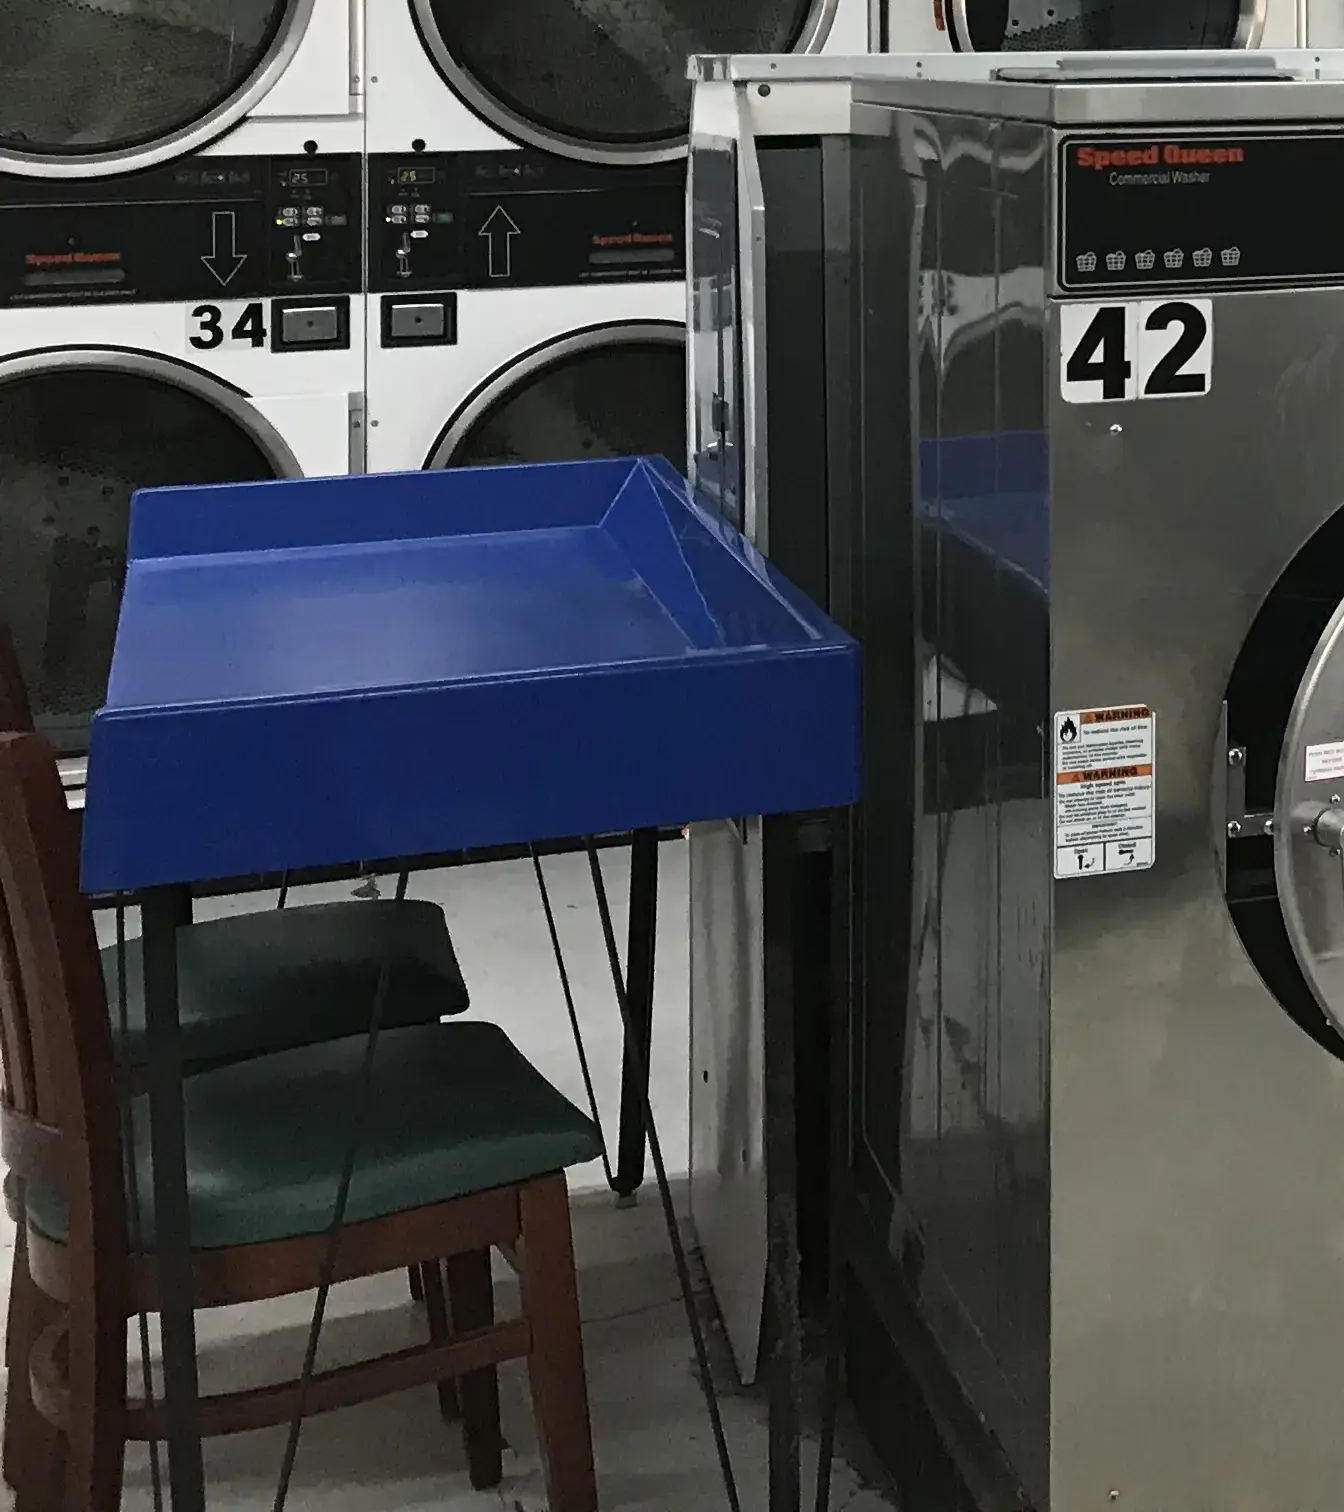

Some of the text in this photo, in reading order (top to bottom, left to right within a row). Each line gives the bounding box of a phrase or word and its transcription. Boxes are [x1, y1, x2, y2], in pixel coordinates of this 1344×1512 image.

[1077, 144, 1245, 170] Speed Queen
[1109, 170, 1211, 186] Commercial Washer
[190, 303, 268, 350] 34
[1067, 302, 1207, 399] 42
[1096, 708, 1150, 722] WARNING
[1083, 766, 1138, 781] WARNING
